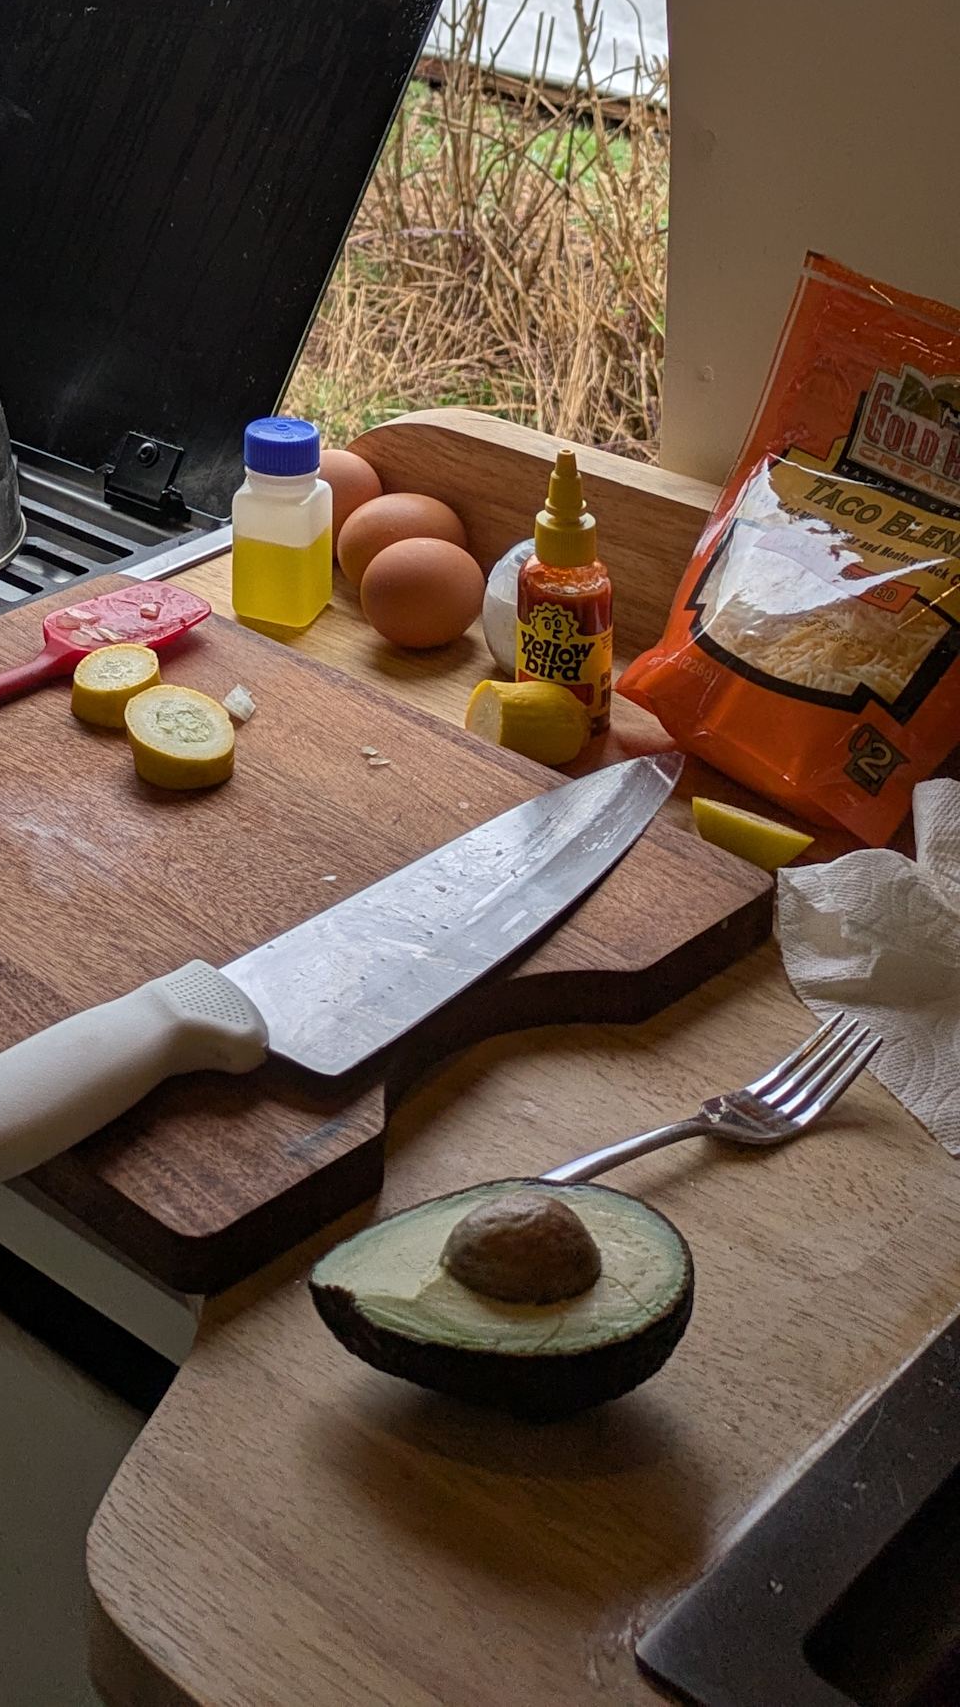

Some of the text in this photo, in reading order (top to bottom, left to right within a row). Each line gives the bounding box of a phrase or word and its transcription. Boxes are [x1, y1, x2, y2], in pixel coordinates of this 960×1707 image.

[863, 381, 941, 468] GOLD
[803, 476, 882, 525] TACO
[858, 539, 879, 553] and
[924, 564, 951, 581] ack
[521, 629, 596, 665] Yellow
[525, 648, 581, 682] bird
[856, 741, 893, 782] 2
